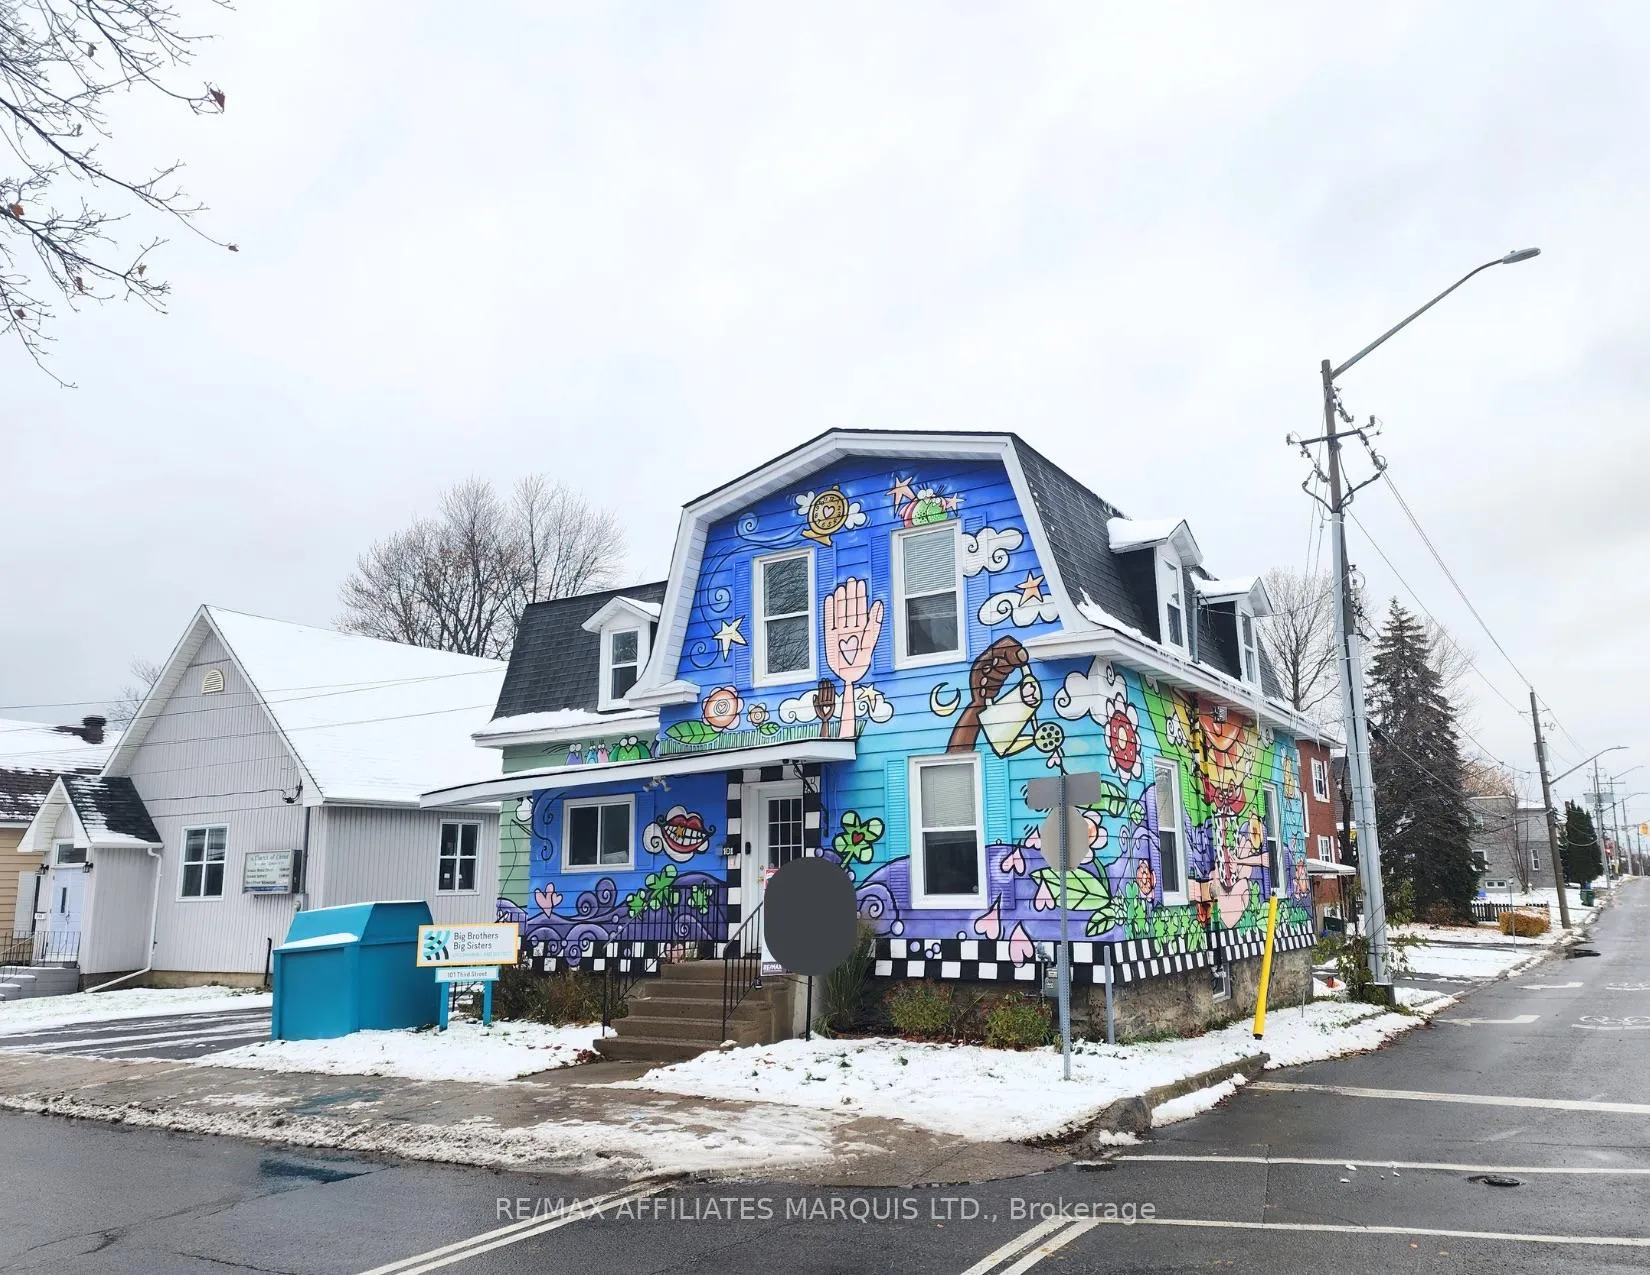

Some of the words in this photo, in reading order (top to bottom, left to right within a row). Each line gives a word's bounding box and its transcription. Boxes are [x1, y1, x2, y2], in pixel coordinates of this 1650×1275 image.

[723, 847, 733, 855] 101
[453, 932, 466, 942] Big
[467, 931, 499, 940] Brothers
[453, 942, 466, 952] Big
[467, 942, 492, 950] Sisters
